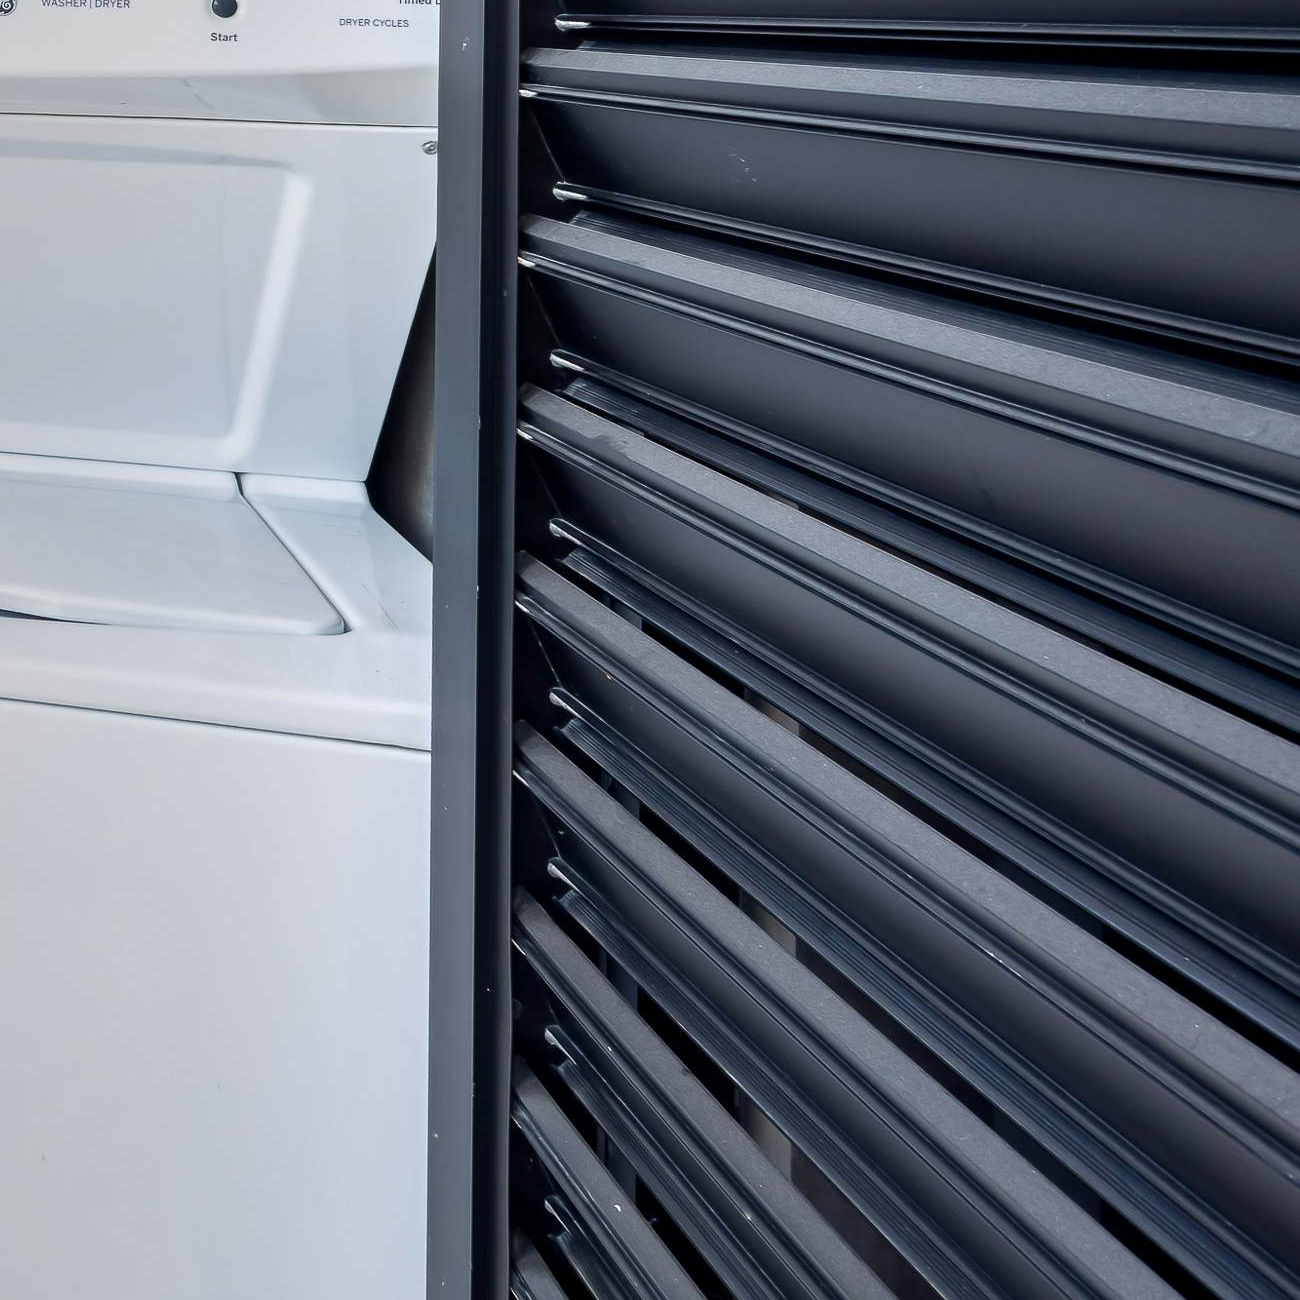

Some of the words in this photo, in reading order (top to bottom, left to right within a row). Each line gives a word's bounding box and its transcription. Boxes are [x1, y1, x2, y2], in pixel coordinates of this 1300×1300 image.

[95, 0, 130, 8] DRYER
[339, 18, 371, 27] DRYER
[372, 19, 410, 28] CYCLES
[211, 32, 237, 42] Start
